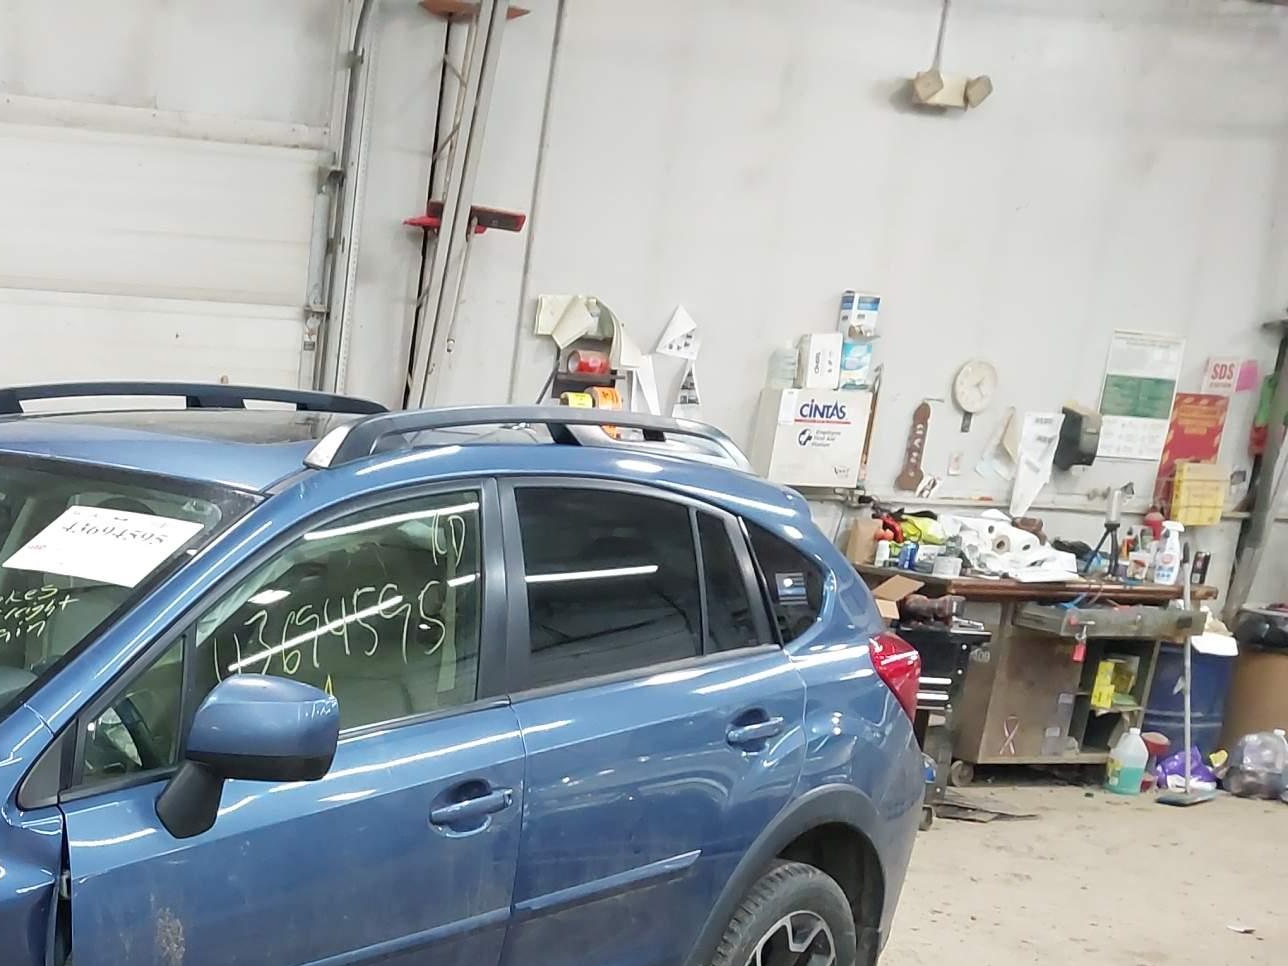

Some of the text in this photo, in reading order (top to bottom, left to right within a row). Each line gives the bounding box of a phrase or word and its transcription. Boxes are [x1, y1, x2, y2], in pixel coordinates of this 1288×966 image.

[1211, 363, 1235, 380] SDS
[800, 399, 846, 420] CINTAS
[214, 580, 446, 684] 43694595
